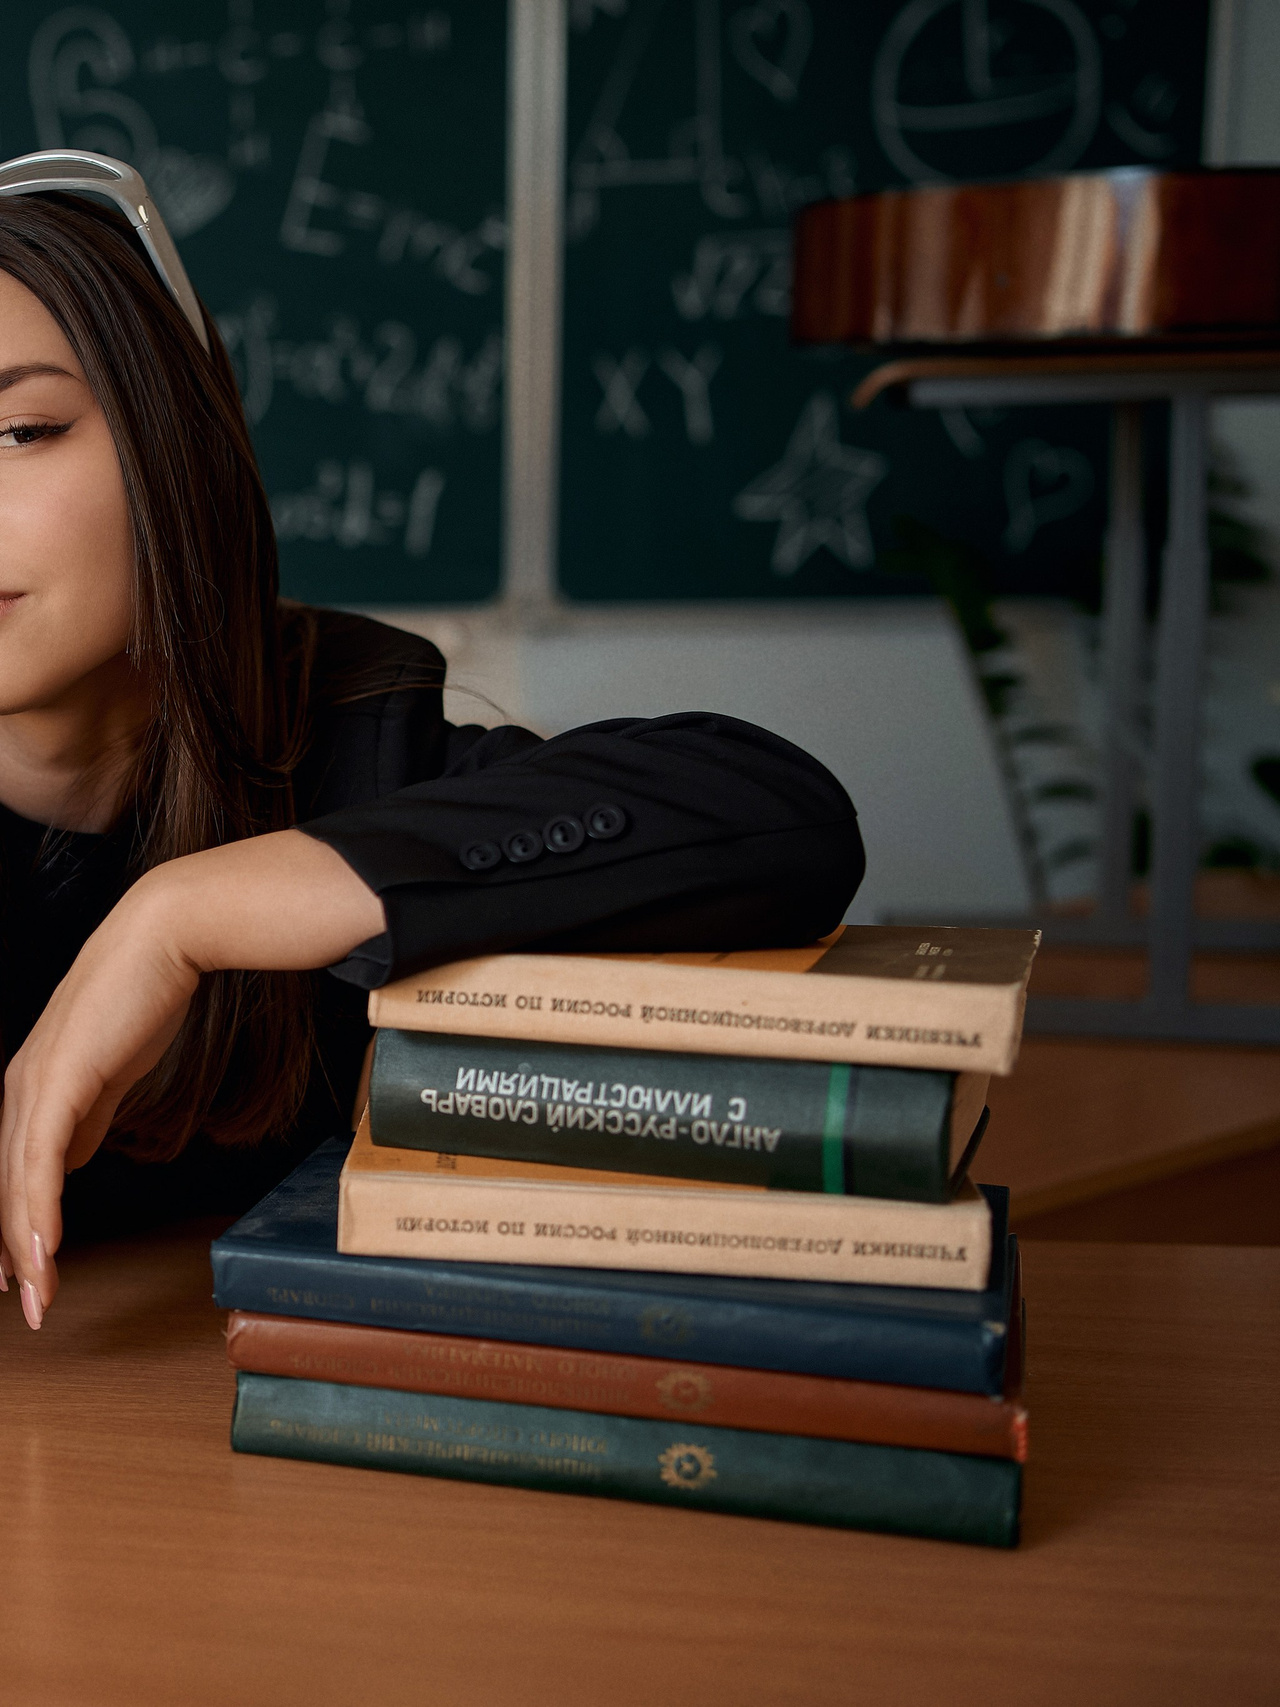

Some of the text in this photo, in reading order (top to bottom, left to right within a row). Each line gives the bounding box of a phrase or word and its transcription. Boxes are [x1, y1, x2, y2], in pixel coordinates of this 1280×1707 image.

[417, 988, 984, 1049] УЧЕБНИКИ ДОРЕВОЛЮЦИОННОЙ РОССИИ ПО ИСТОРИИ
[421, 1088, 781, 1153] АНГЛО-РУССКИЙ СЛОВАРЬ
[455, 1066, 748, 1122] С ИЛЛЮСТРАЦИЯМИ
[396, 1217, 968, 1262] УЧЕБНИКИ ДОРЕВОЛЮЦИОННОЙ РОССИИ ПО ИСТОРИИ
